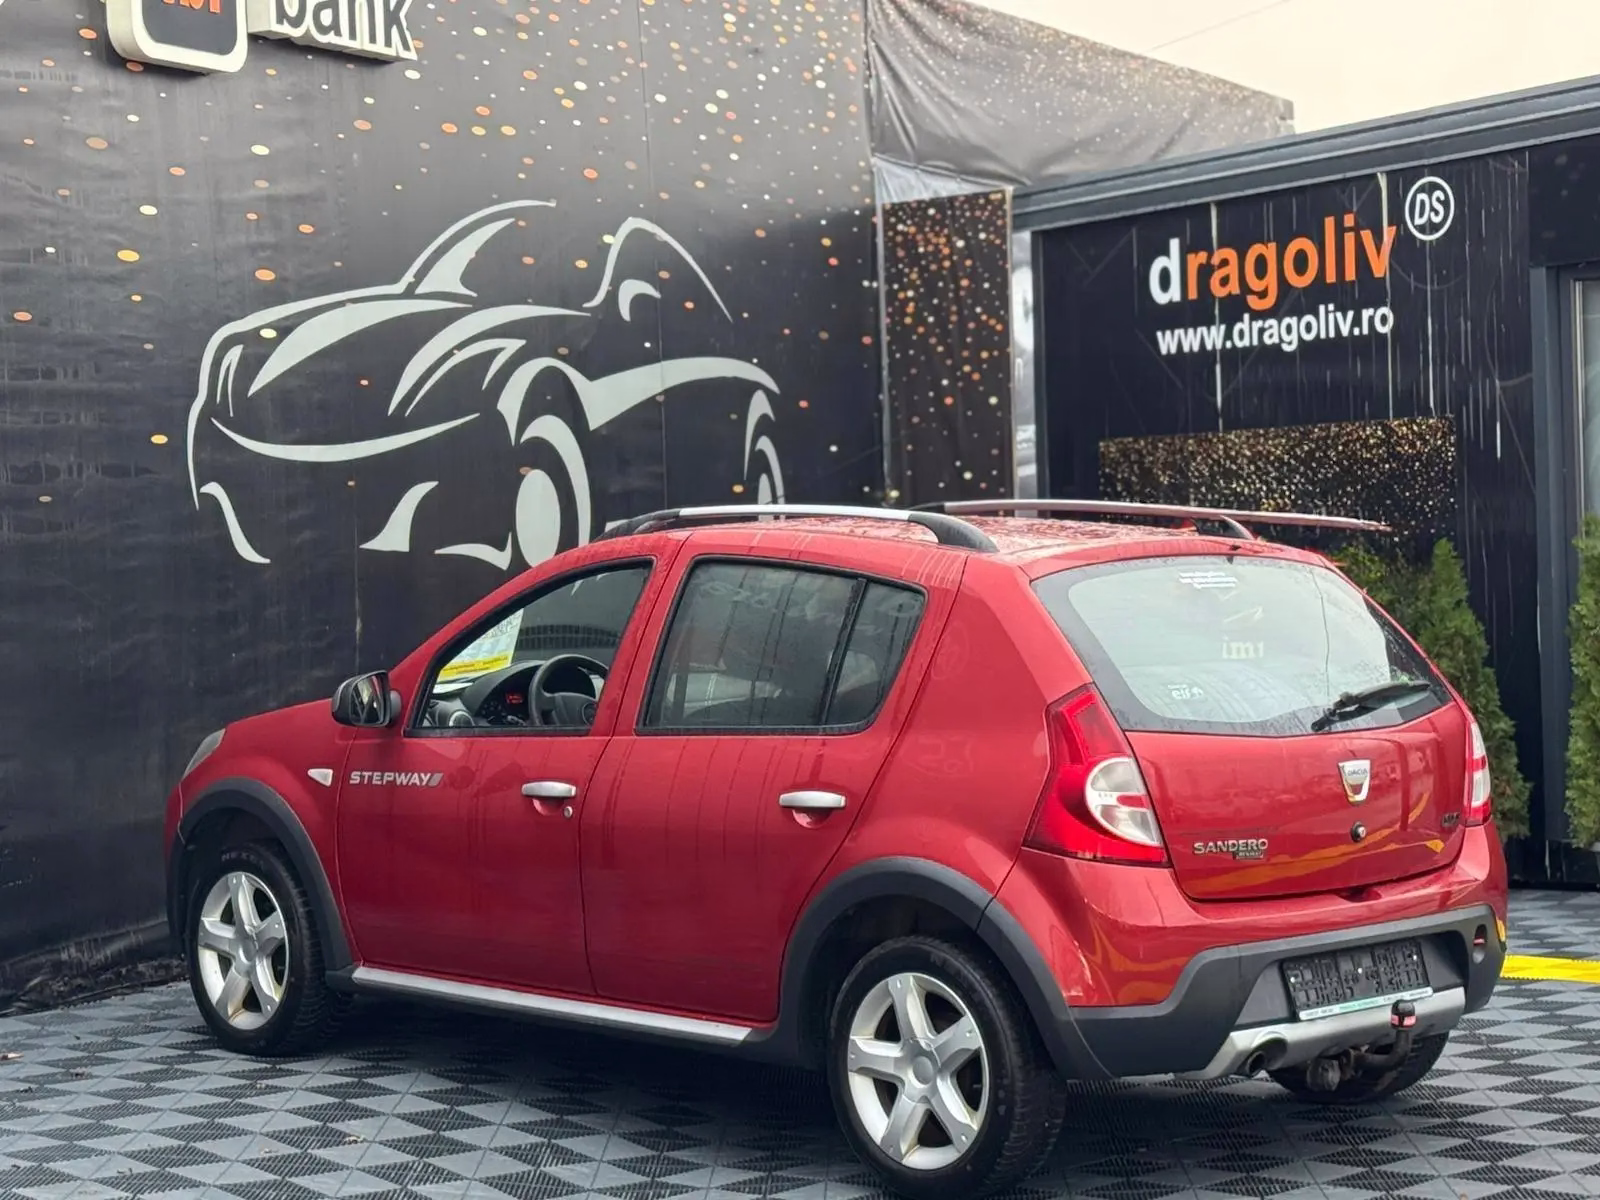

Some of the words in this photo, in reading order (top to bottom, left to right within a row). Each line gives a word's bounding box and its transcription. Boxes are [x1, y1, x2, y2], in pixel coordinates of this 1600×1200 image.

[275, 0, 412, 53] bank
[1413, 188, 1446, 227] DS
[1150, 213, 1397, 311] dragoliv
[1156, 303, 1394, 355] www.dragoliv.ro
[349, 770, 432, 787] STEPWAY
[1192, 838, 1269, 855] SANDERO
